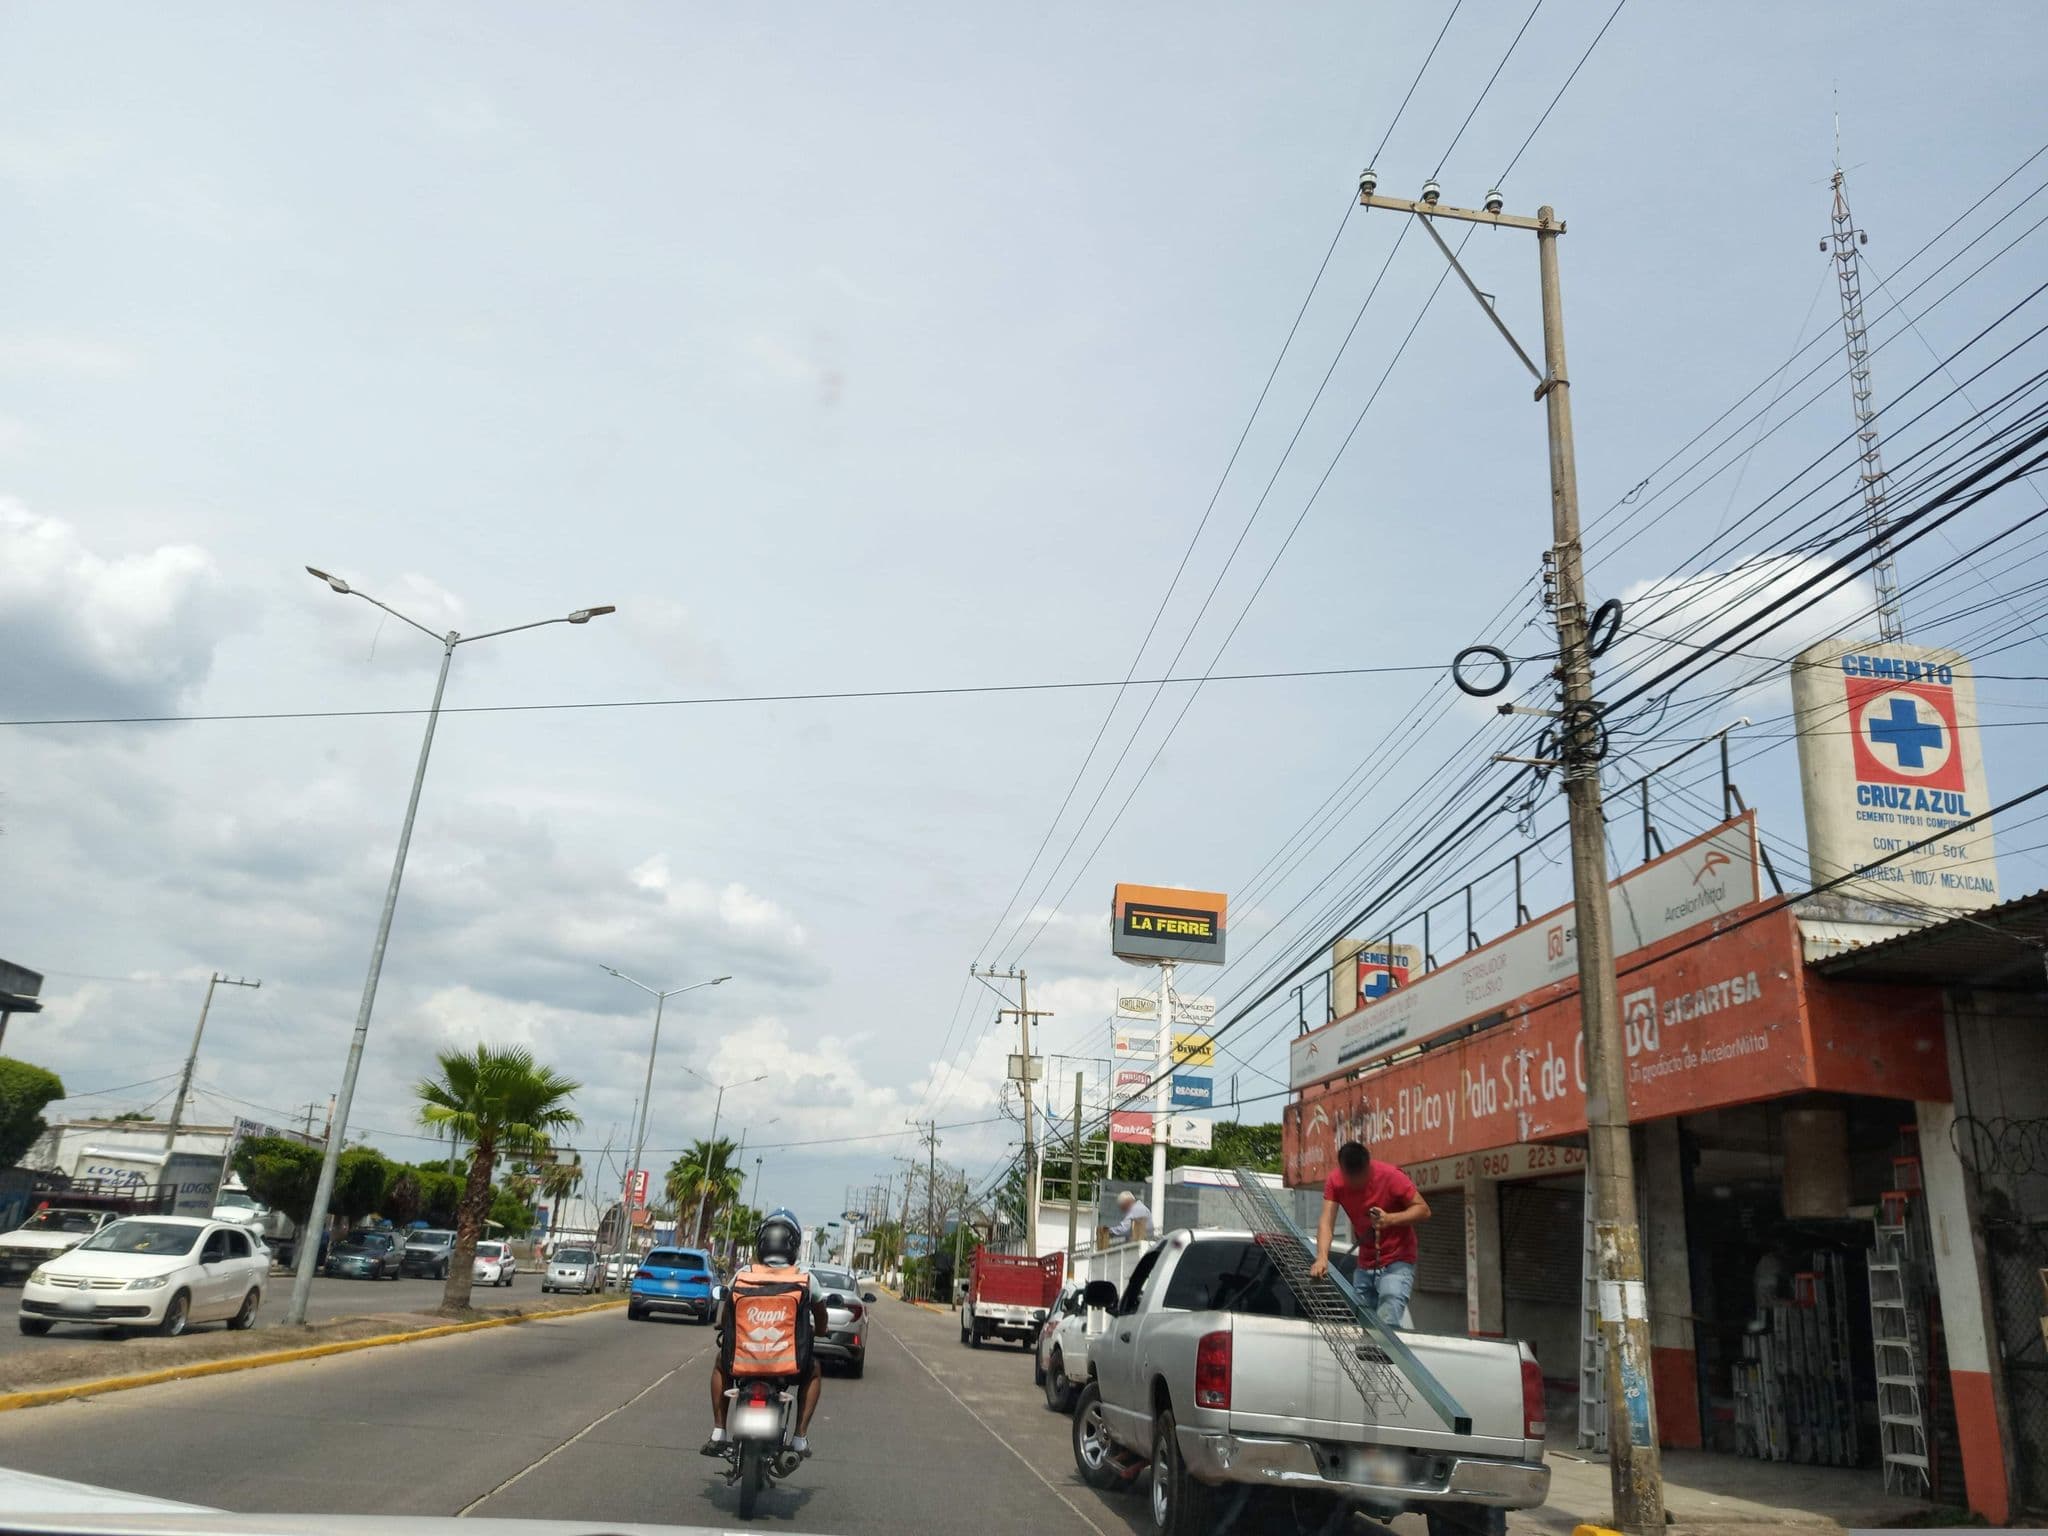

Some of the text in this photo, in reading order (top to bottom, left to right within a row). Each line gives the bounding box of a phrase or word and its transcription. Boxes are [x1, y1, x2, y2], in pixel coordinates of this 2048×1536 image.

[1842, 655, 1953, 685] CEMENTO
[1857, 785, 1971, 817] CRUZ AZUL
[1856, 810, 1895, 824] CEMENTO
[1897, 814, 1915, 826] TIPO
[1853, 863, 1996, 893] EMPRESA 100% MEXICANA
[1132, 916, 1152, 930] LA
[1663, 971, 1761, 1027] SICARTSA
[1701, 1030, 1769, 1065] ArcelorMittal
[1413, 1082, 1442, 1131] Pico
[1446, 1089, 1457, 1145] y
[1462, 1064, 1497, 1120] Pala
[1541, 1040, 1568, 1102] de
[1528, 1147, 1556, 1169] 223
[181, 1183, 213, 1194] LOGIS
[746, 1306, 787, 1326] Rappi
